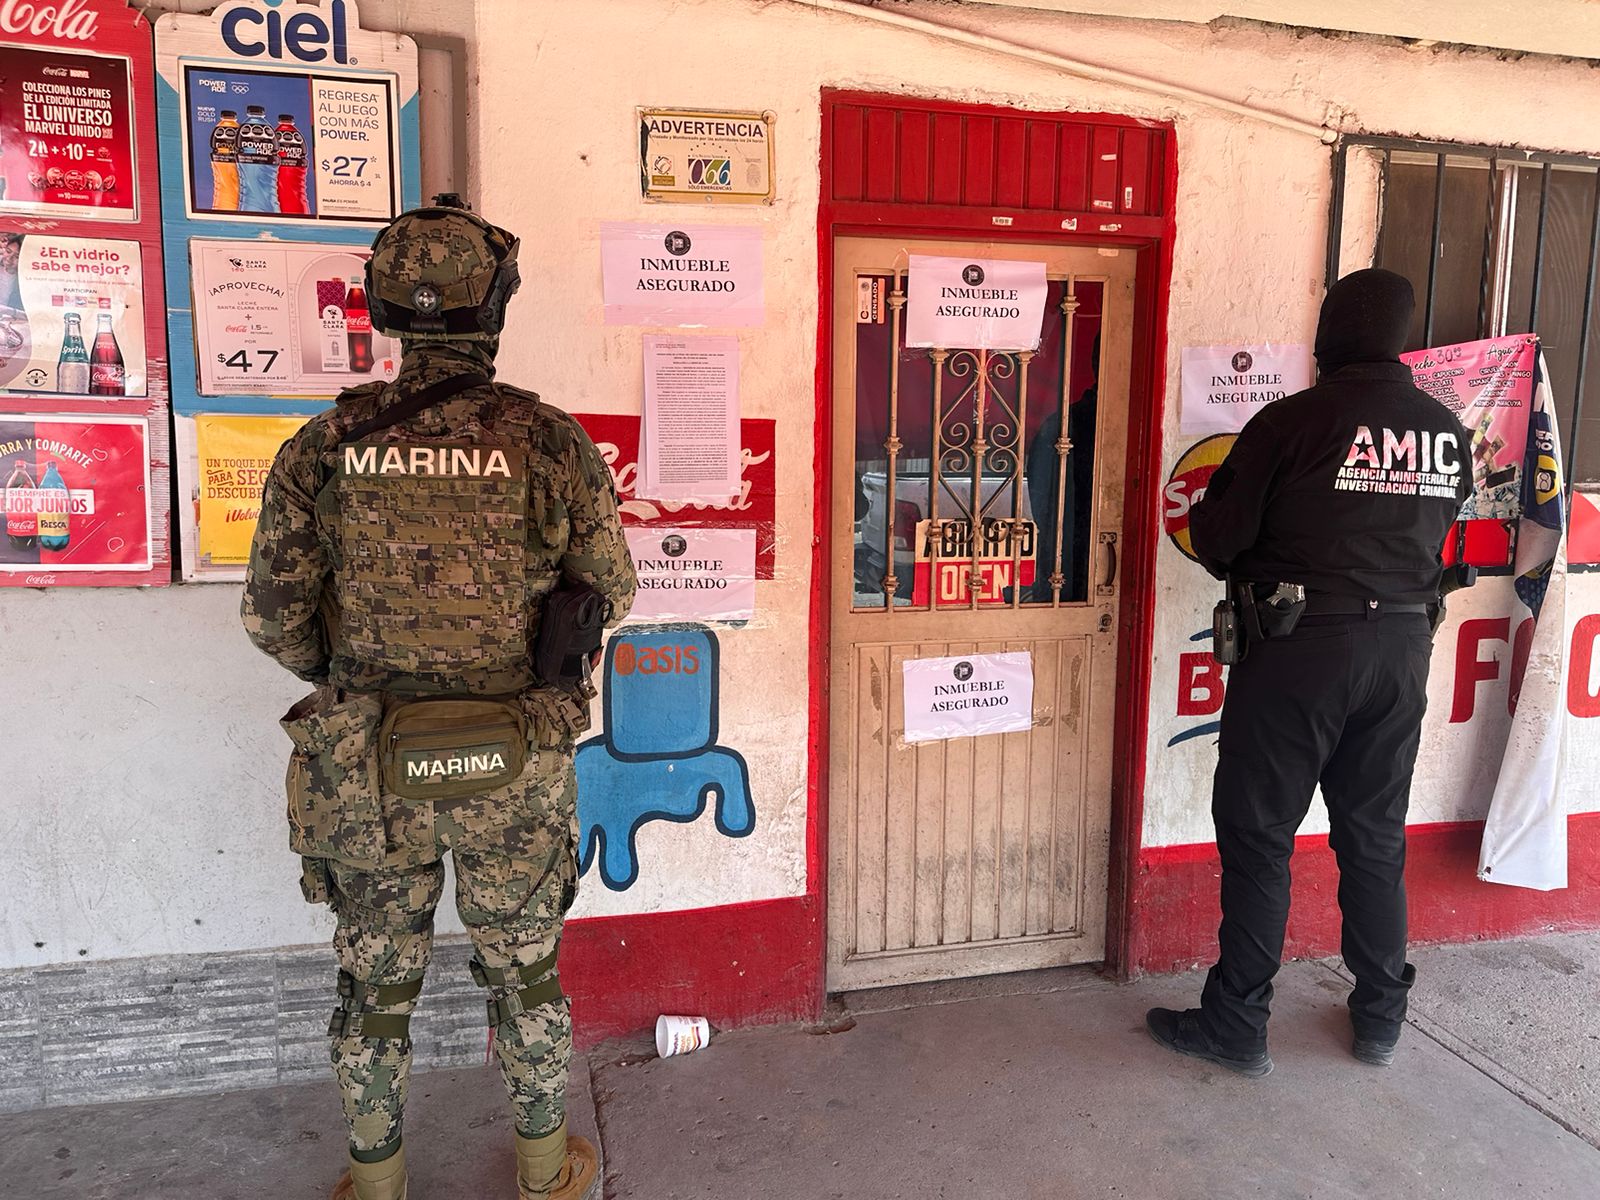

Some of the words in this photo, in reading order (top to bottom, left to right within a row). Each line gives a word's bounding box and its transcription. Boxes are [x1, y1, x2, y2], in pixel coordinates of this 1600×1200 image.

[221, 0, 347, 64] ciel
[22, 81, 71, 96] COLECCIONA
[72, 86, 87, 97] LOS
[88, 88, 111, 99] PINES
[198, 79, 226, 88] POWER
[23, 93, 34, 102] DE
[35, 94, 45, 104] LA
[45, 95, 75, 107] EDICIÓN
[76, 98, 112, 110] LIMITADA
[319, 89, 378, 103] REGRESA
[24, 103, 41, 120] EL
[43, 105, 113, 127] UNIVERSO
[319, 103, 335, 113] AL
[337, 104, 379, 116] JUEGO
[25, 120, 68, 136] MARVEL
[69, 124, 102, 139] UNIDO
[319, 116, 347, 128] CON
[351, 117, 380, 130] MÁS
[650, 120, 764, 138] ADVERTENCIA
[320, 129, 370, 142] POWER.
[690, 158, 730, 185] 066
[329, 179, 360, 187] AHORRA
[40, 247, 69, 259] ¿En
[73, 248, 120, 261] vidrio
[31, 261, 71, 272] sabe
[76, 263, 130, 277] mejor?
[640, 258, 730, 272] INMUEBLE
[208, 281, 285, 298] ¡APROVECHA!
[636, 278, 736, 292] ASEGURADO
[941, 287, 1018, 301] INMUEBLE
[935, 305, 1020, 319] ASEGURADO
[1486, 343, 1512, 362] Agua
[1211, 374, 1282, 386] INMUEBLE
[1207, 391, 1286, 404] ASEGURADO
[35, 438, 93, 470] COMPARTE
[1343, 425, 1460, 475] AMIC
[206, 458, 221, 468] UN
[223, 458, 255, 469] TOQUE
[257, 459, 271, 468] DE
[345, 446, 512, 478] MARINA
[208, 471, 233, 485] PARA
[1337, 466, 1386, 481] AGENCIA
[1389, 470, 1449, 486] MINISTERIAL
[1449, 476, 1461, 487] DE
[54, 490, 65, 498] ES
[1334, 478, 1417, 496] INVESTIGACIÓN
[1419, 484, 1456, 499] CRIMINAL
[37, 498, 87, 513] JUNTOS
[40, 519, 67, 529] FRESCA
[637, 559, 723, 571] INMUEBLE
[614, 643, 699, 676] Oasis
[934, 680, 1005, 696] INMUEBLE
[930, 695, 1009, 712] ASEGURADO
[407, 753, 505, 777] MARINA
